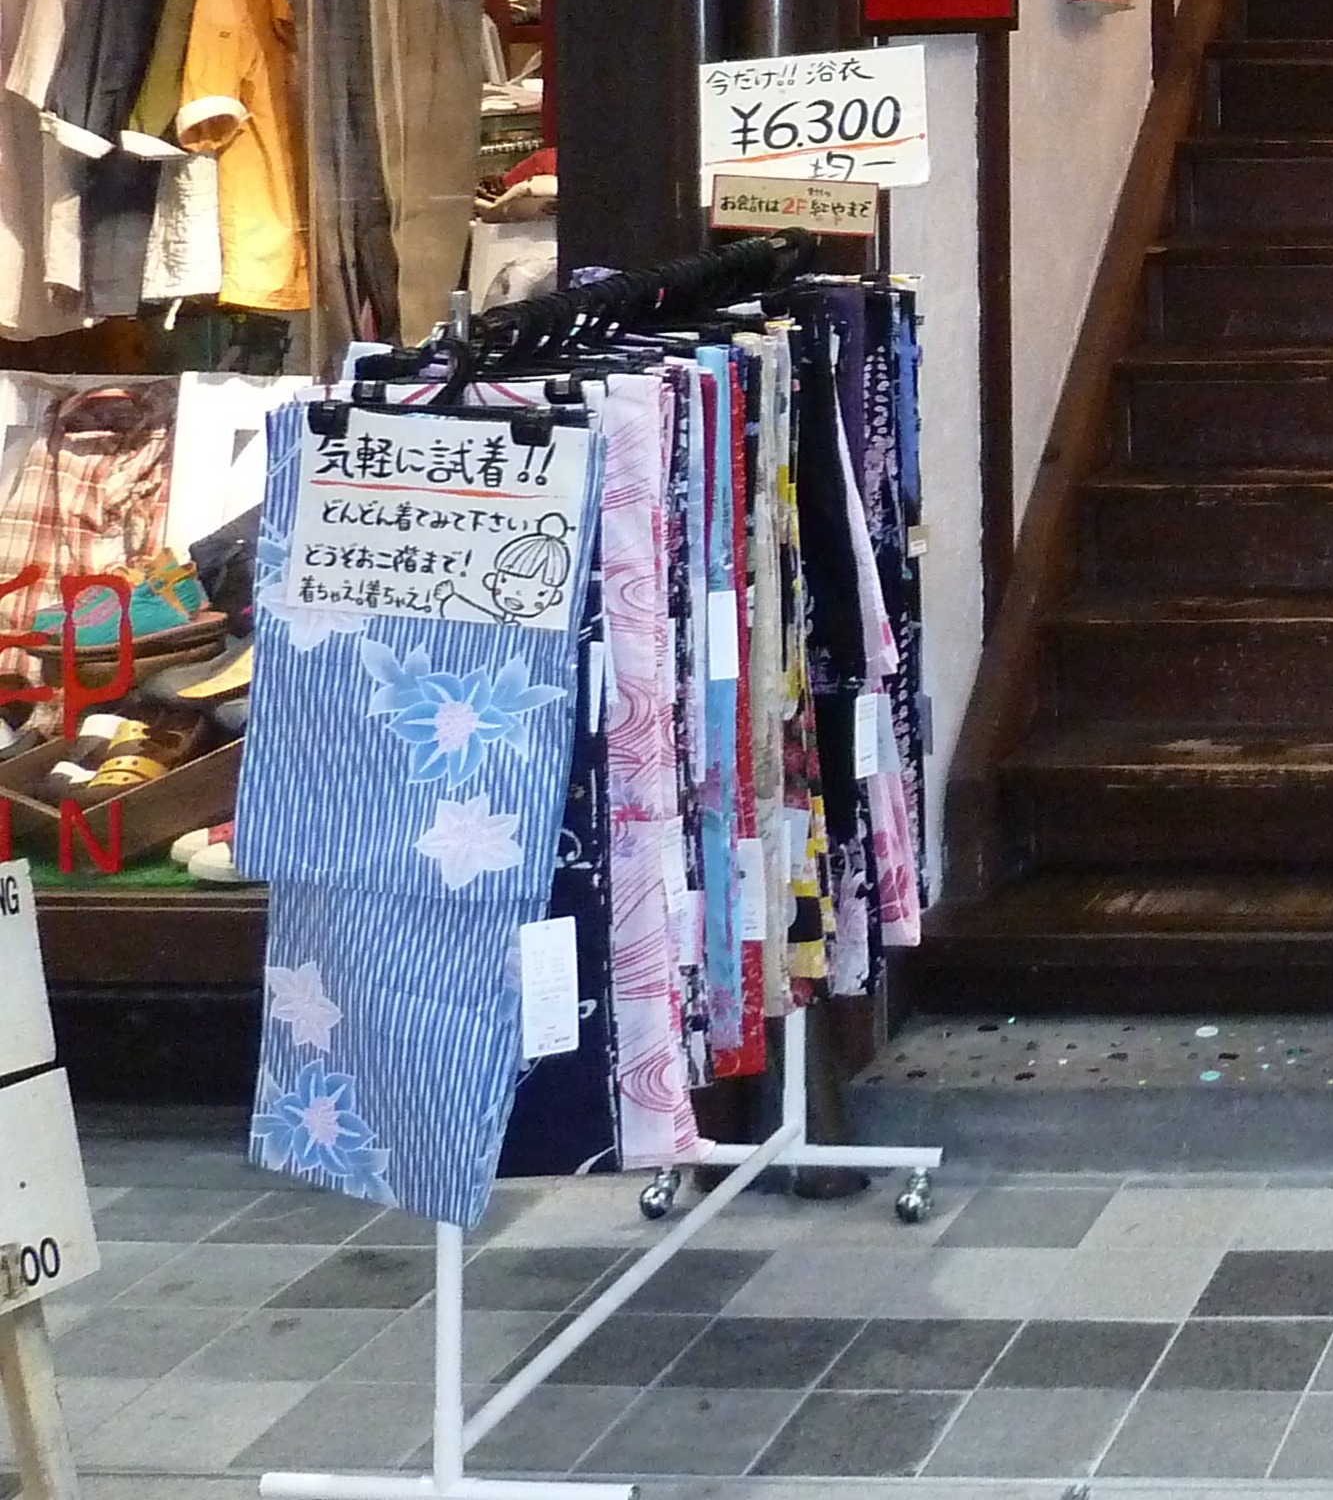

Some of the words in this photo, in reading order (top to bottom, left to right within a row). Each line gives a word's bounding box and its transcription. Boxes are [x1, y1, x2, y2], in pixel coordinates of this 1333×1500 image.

[706, 63, 798, 96] 今だけ!!
[805, 57, 875, 85] 浴衣
[315, 432, 556, 487] 気軽に試着!!
[322, 499, 532, 534] どんどん着てみて下さい
